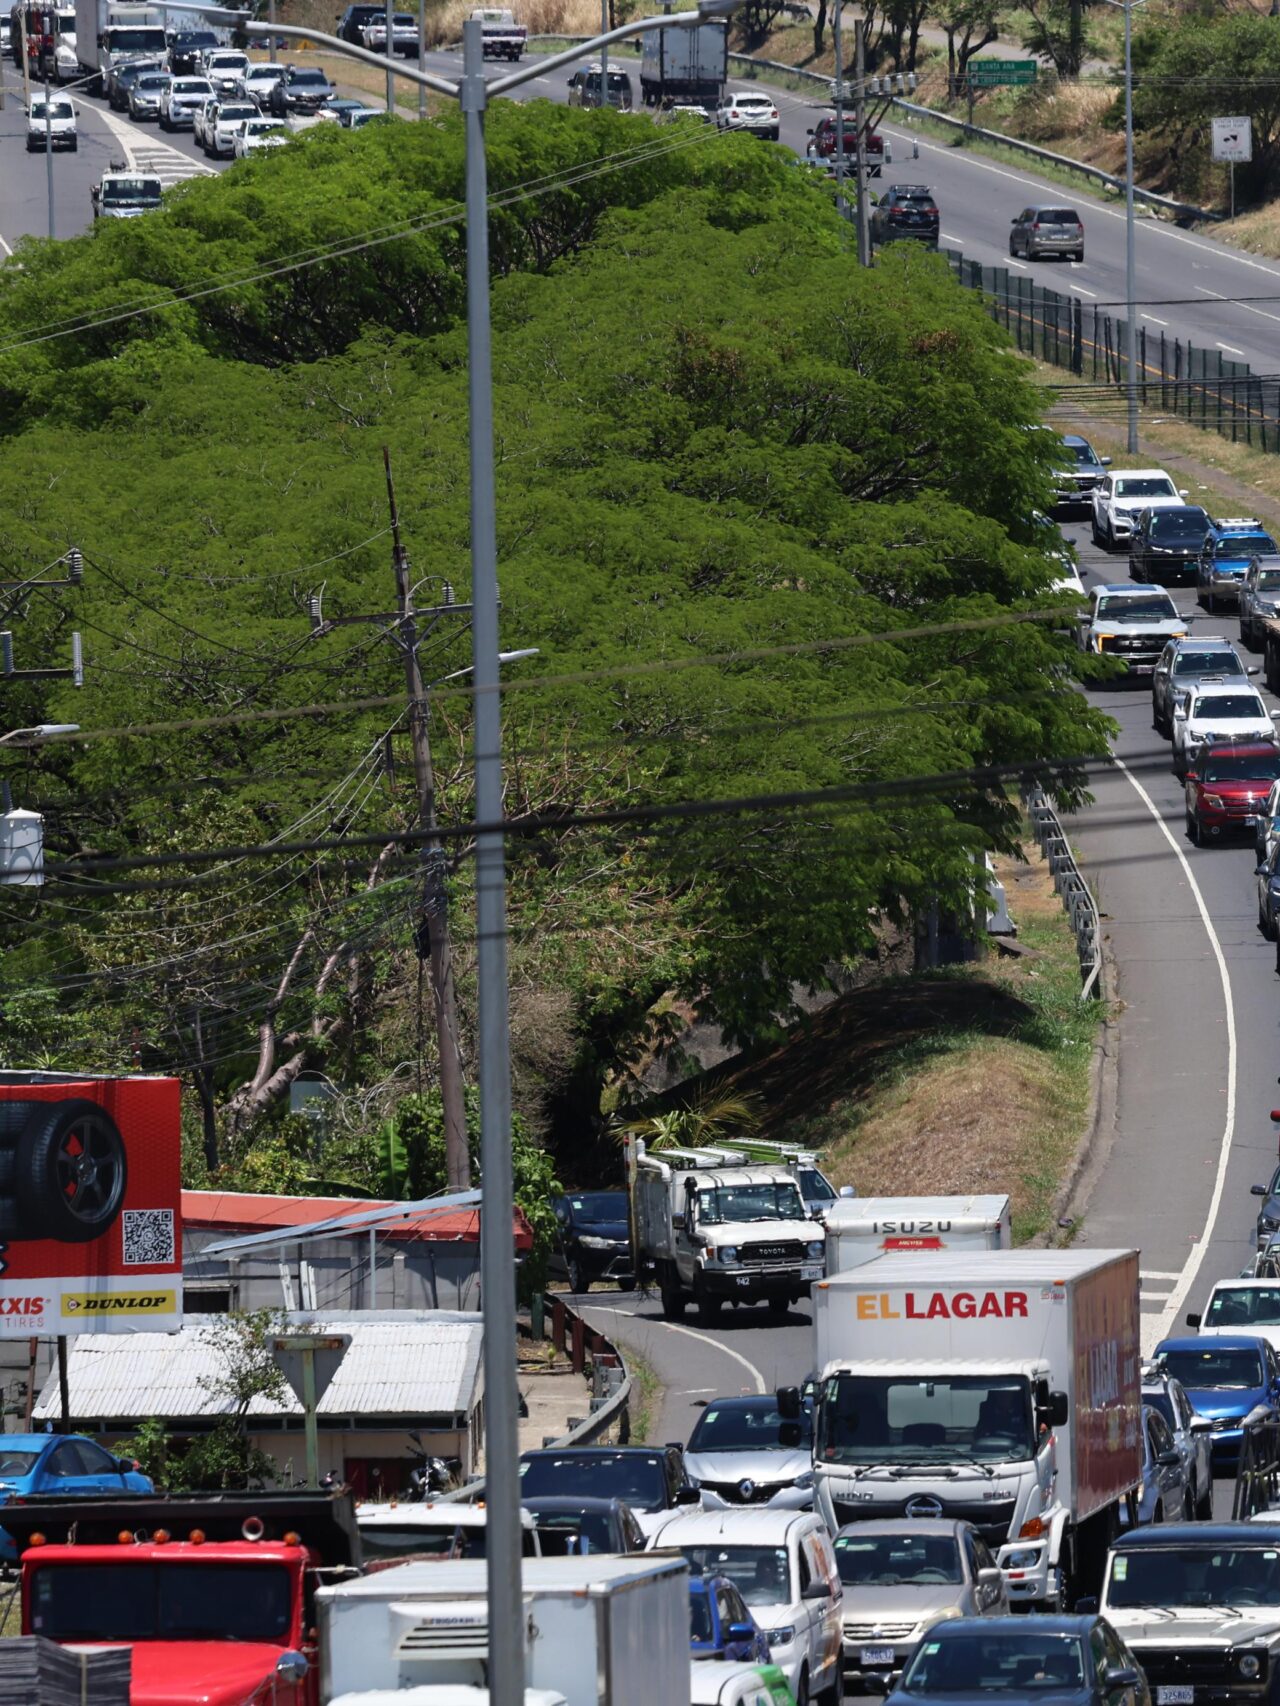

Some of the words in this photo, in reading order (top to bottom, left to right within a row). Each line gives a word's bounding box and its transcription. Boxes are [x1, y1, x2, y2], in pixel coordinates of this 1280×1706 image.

[981, 62, 1000, 70] SANTA
[1002, 62, 1015, 70] ANA
[872, 1220, 952, 1234] ISUZU
[758, 1247, 786, 1255] TOYOTA
[735, 1276, 751, 1286] 942
[83, 1296, 167, 1310] DUNLOP
[856, 1293, 900, 1320] EL
[905, 1291, 1029, 1320] LAGAR
[5, 1316, 45, 1328] TIRES
